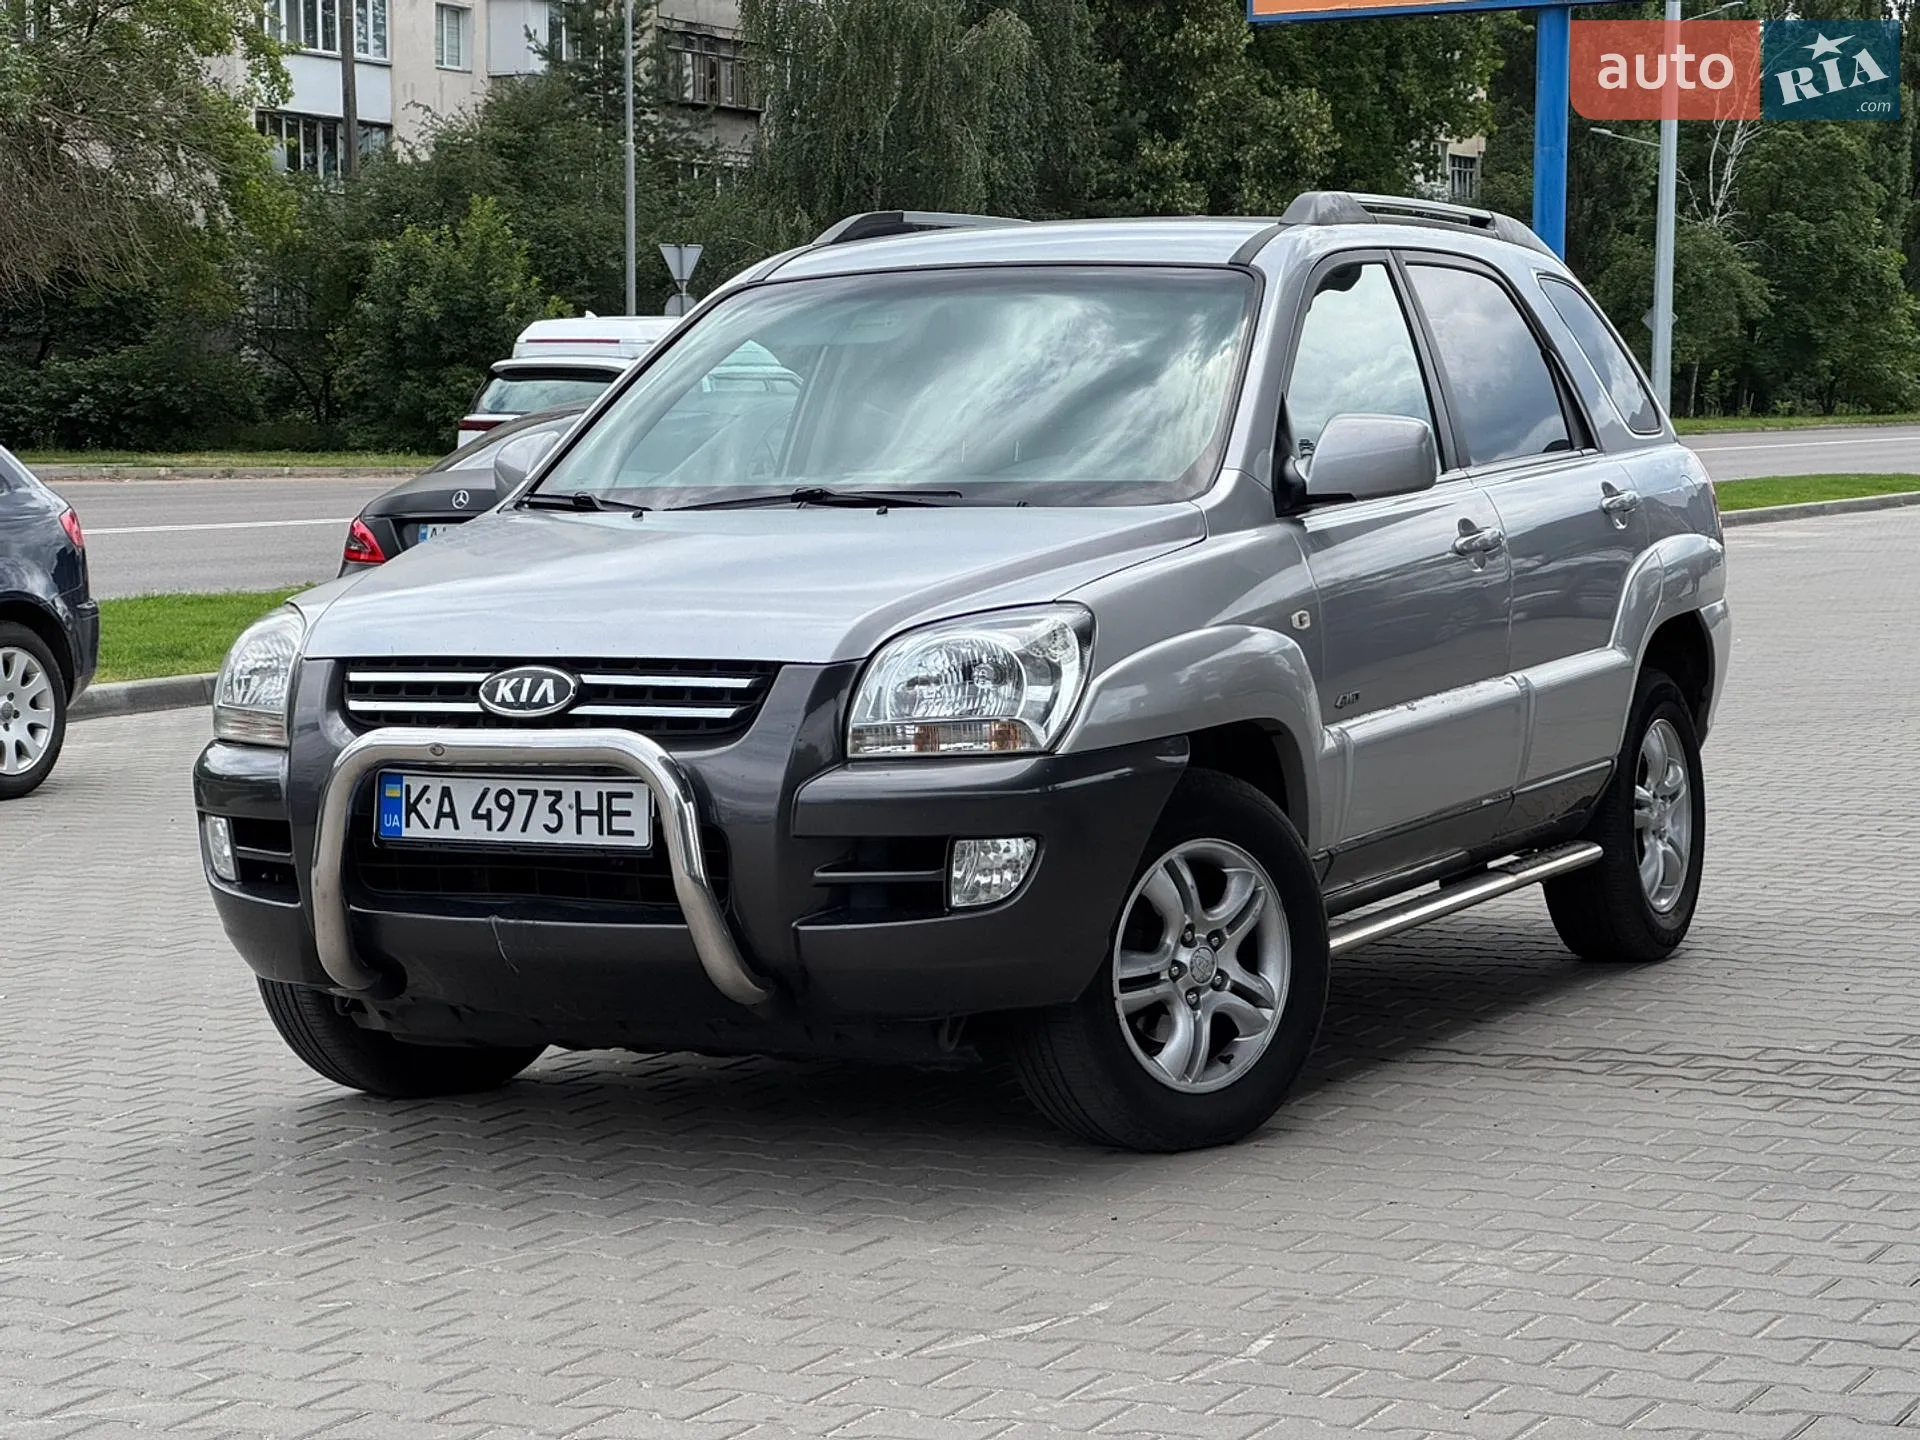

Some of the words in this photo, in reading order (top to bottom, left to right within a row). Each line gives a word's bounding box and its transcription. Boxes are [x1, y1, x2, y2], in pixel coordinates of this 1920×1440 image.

[494, 677, 555, 704] KIA
[384, 813, 400, 828] UA
[404, 783, 460, 831] KA
[471, 787, 564, 834] 4973
[574, 790, 635, 837] HE
